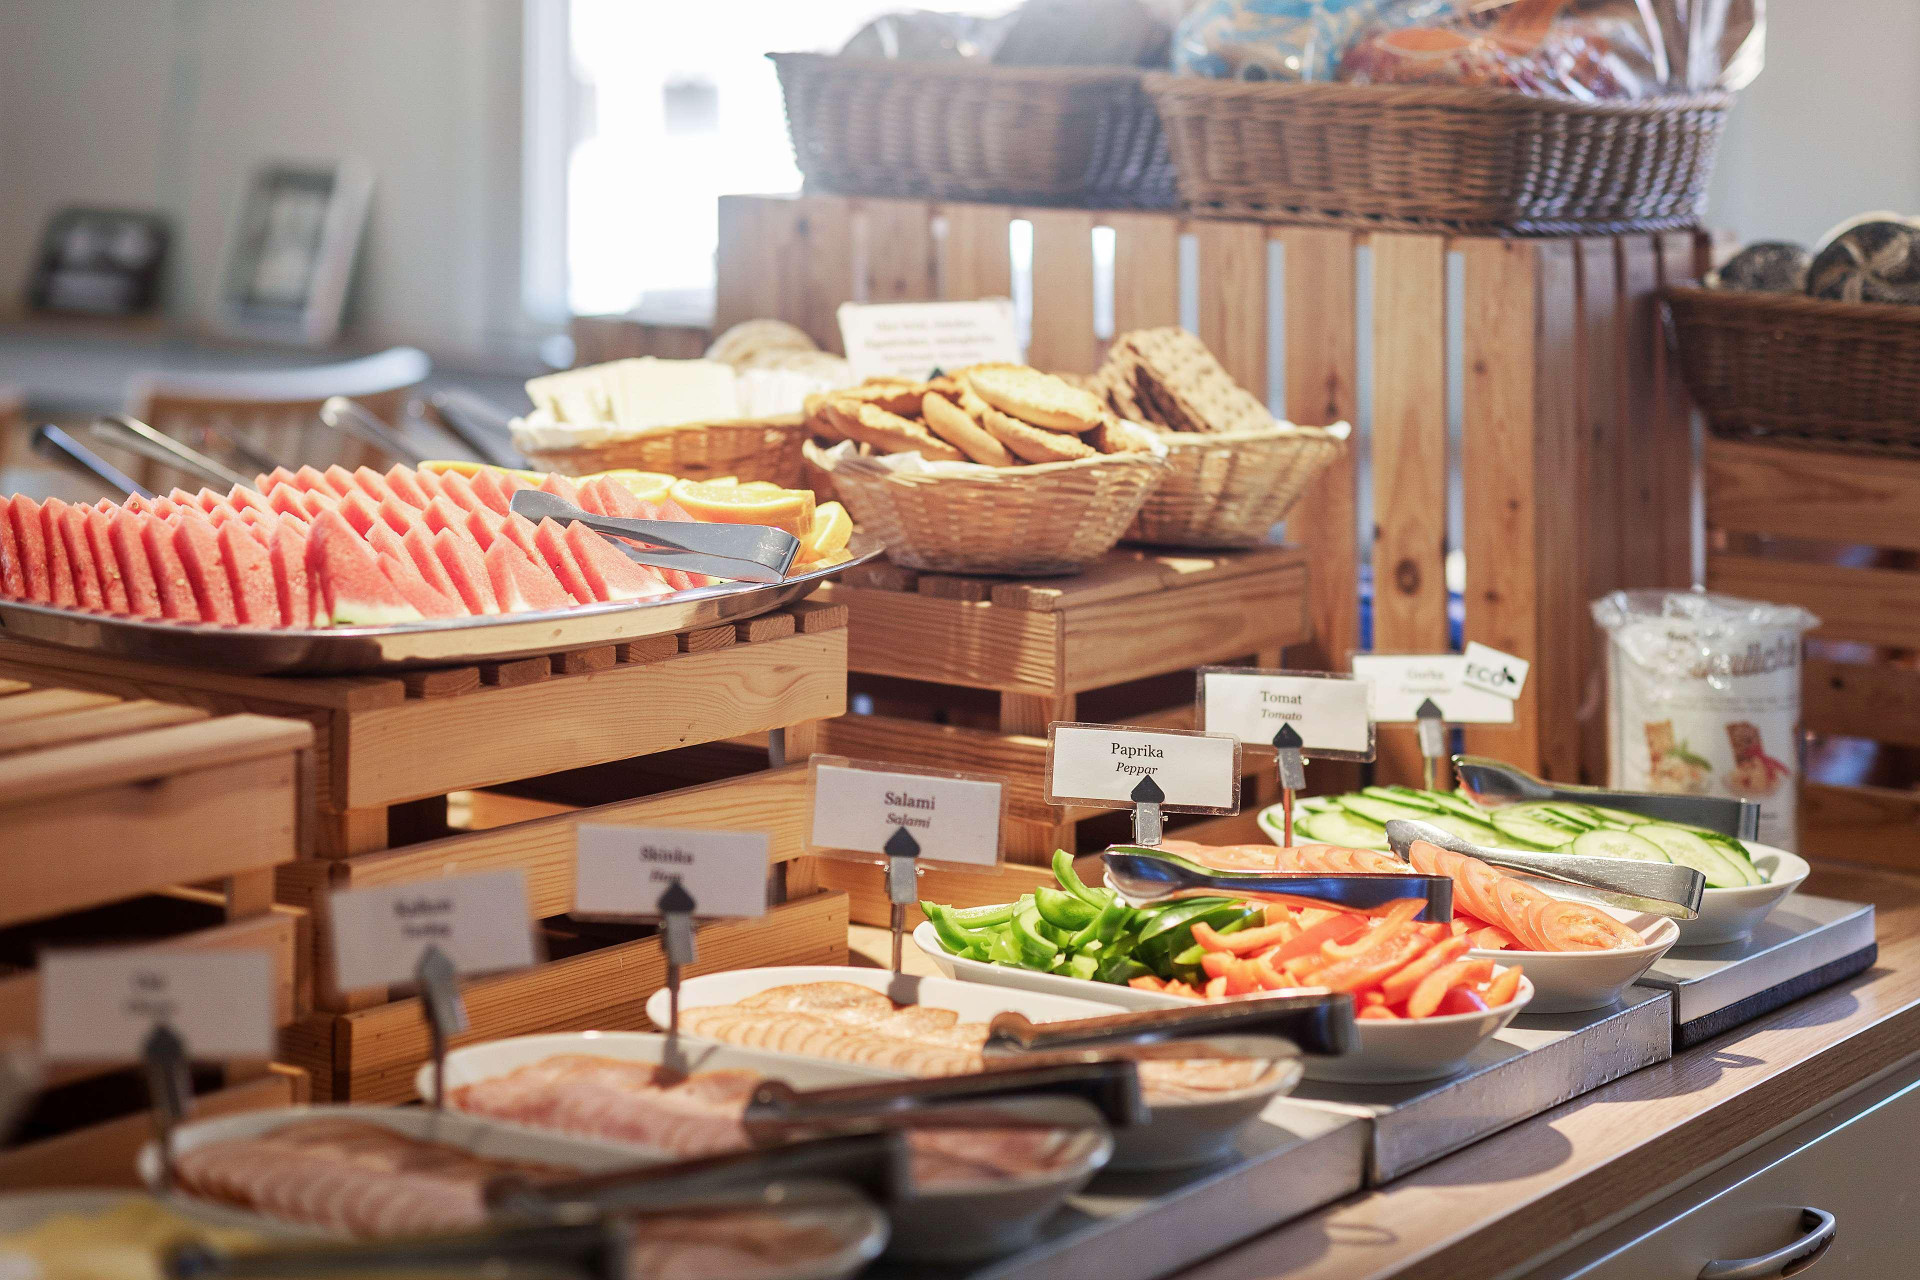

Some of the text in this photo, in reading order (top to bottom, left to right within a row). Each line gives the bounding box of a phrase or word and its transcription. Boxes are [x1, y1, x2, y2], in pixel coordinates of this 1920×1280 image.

[1260, 690, 1303, 705] Tomat
[1261, 708, 1303, 721] Tomato
[1110, 742, 1165, 759] Paprika
[1116, 761, 1158, 776] Peppar
[884, 790, 937, 811] Salami
[885, 812, 932, 829] Salami
[640, 845, 695, 866] Skinka
